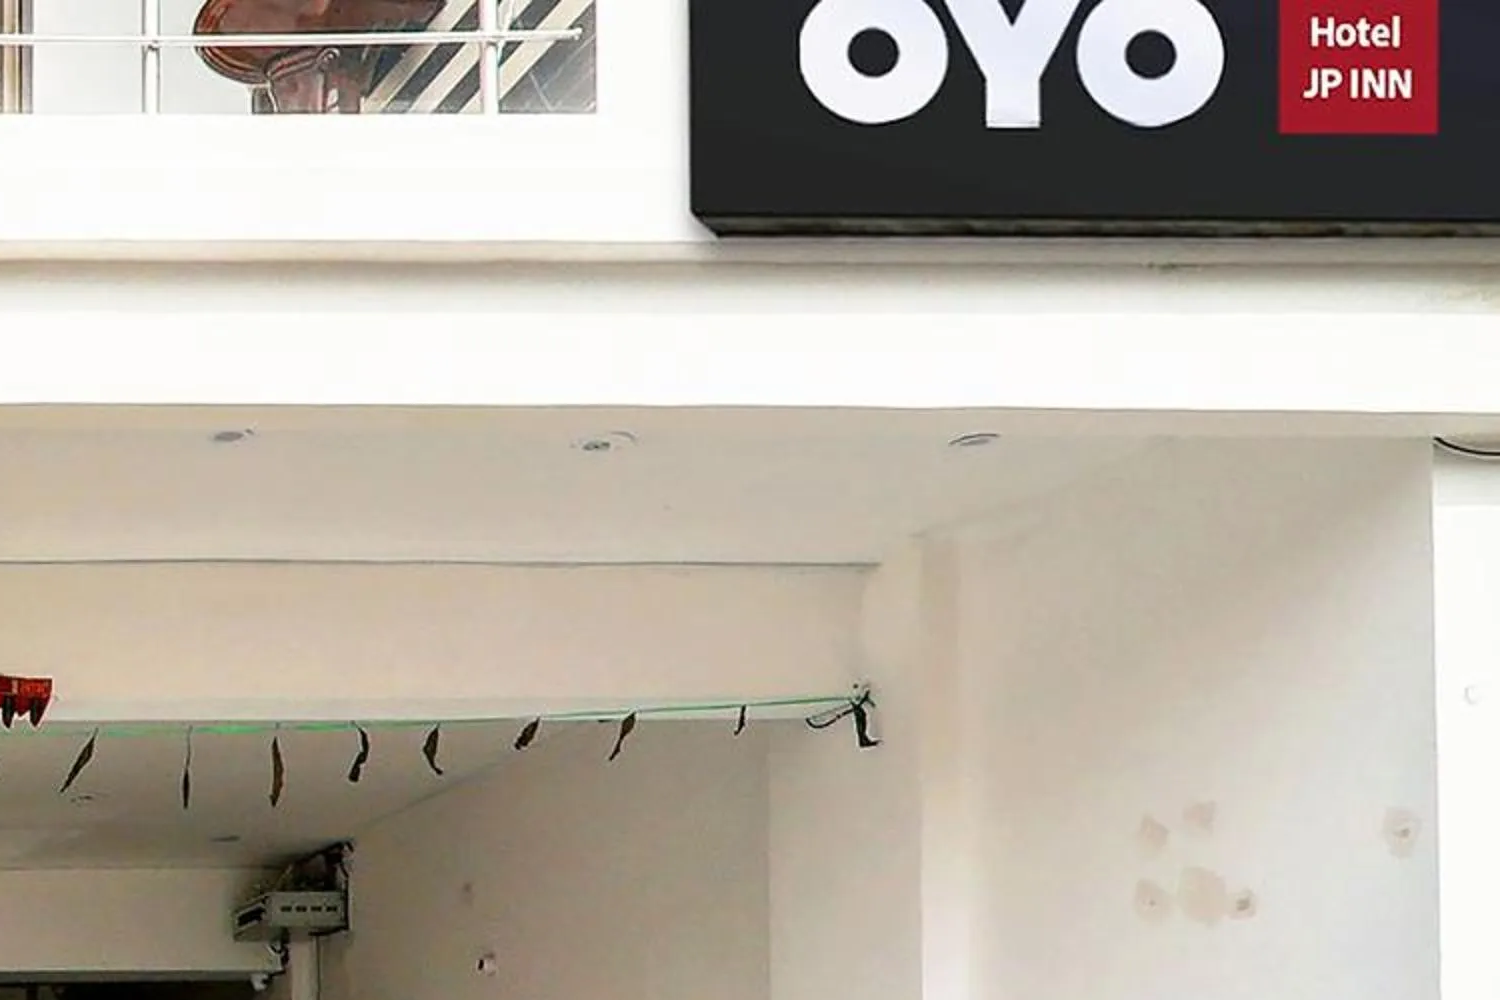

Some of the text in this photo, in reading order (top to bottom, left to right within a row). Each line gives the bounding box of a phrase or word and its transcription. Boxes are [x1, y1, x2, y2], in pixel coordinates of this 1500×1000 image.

[1310, 14, 1401, 48] Hotel
[799, 0, 1225, 128] OYO
[1302, 67, 1413, 99] JP INN
